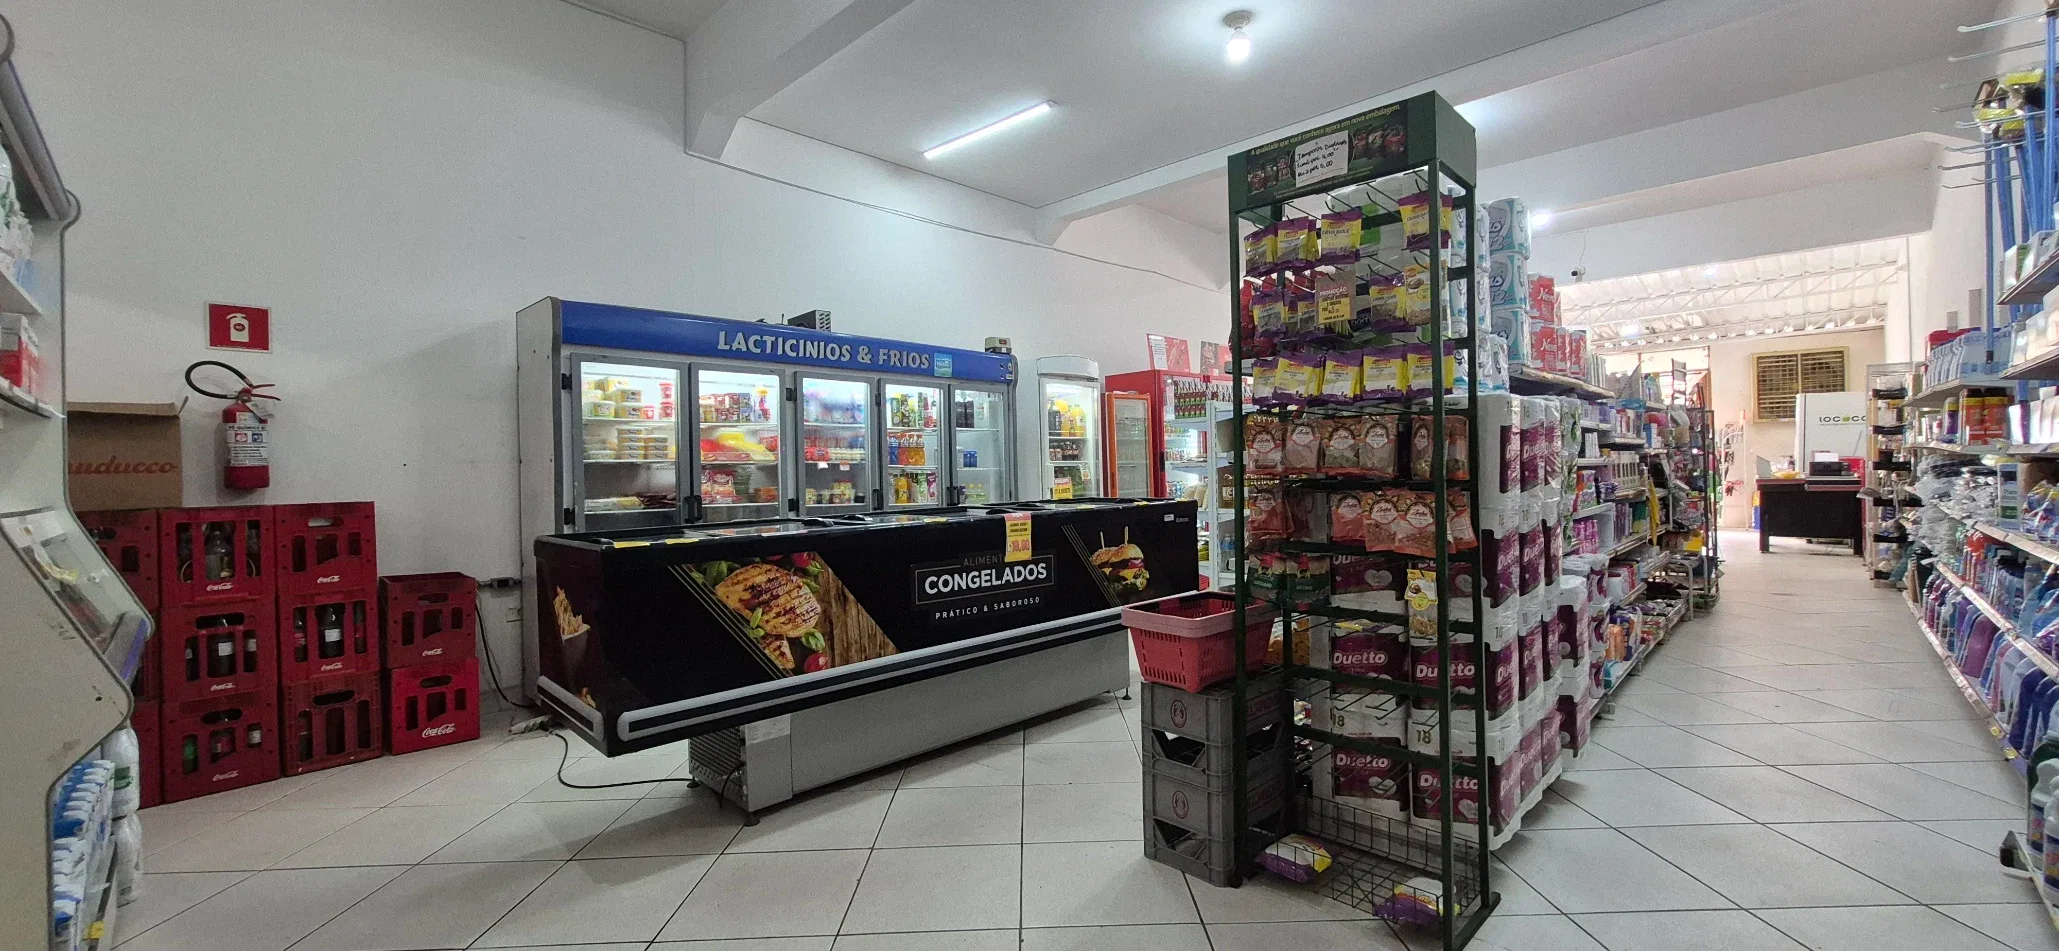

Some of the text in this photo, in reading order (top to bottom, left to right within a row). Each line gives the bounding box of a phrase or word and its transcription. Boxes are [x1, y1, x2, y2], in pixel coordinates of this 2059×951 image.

[1255, 142, 1279, 156] qualidade
[1302, 129, 1324, 140] conhece
[1325, 122, 1341, 134] agora
[717, 330, 931, 370] LACTICINIOS & FRIOS
[962, 554, 1006, 568] ALIMENT
[924, 562, 1047, 595] CONGELADOS
[935, 596, 1040, 620] PRÁTICO & SABOROSO
[1333, 651, 1387, 665] Duetto
[1416, 662, 1475, 678] Dutto
[1416, 729, 1433, 745] 18
[1336, 753, 1389, 768] Duetto
[1420, 774, 1478, 790] Dutto
